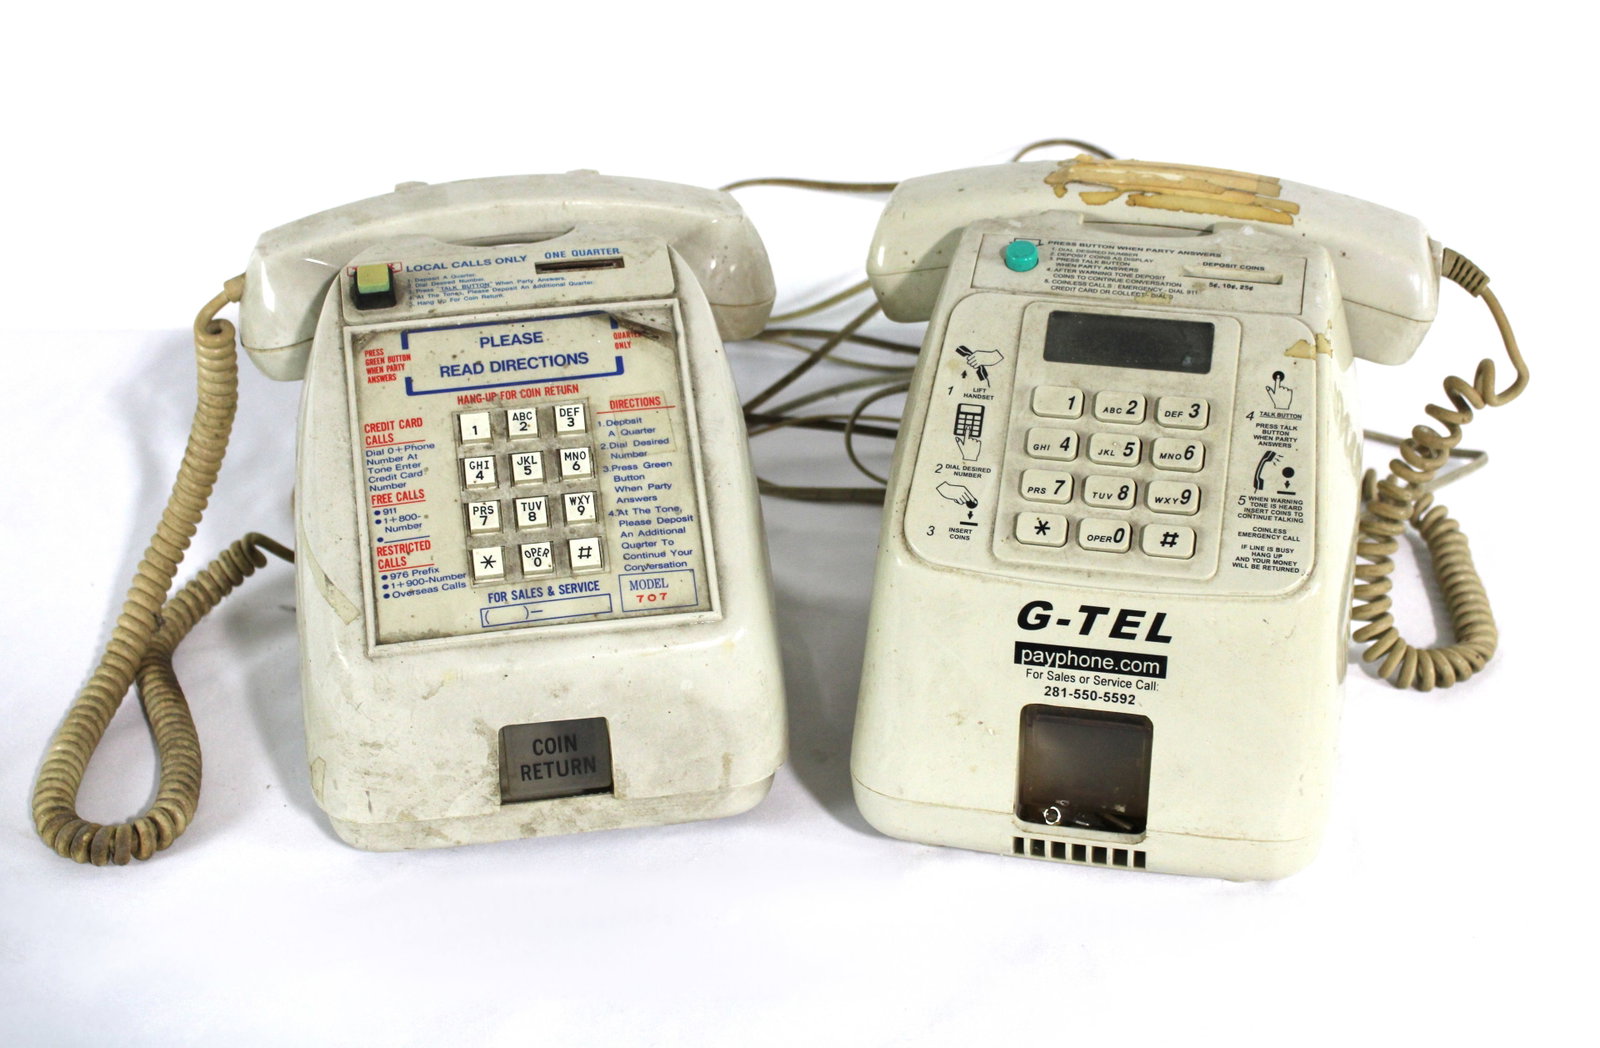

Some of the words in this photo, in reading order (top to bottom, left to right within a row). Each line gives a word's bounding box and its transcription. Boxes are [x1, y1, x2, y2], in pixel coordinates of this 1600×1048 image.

[544, 251, 566, 260] ONE
[571, 248, 620, 258] QUARTER
[406, 262, 449, 273] LOCAL
[451, 258, 492, 270] CALLS
[494, 255, 527, 266] ONLY
[480, 332, 544, 348] PLEASE
[614, 341, 632, 350] ONLY
[364, 348, 384, 357] PRESS
[366, 357, 385, 366] GREEN
[388, 354, 411, 363] BUTTON
[440, 364, 484, 378] READ
[490, 352, 589, 372] DIRECTIONS
[366, 366, 384, 374] WHEN
[387, 364, 405, 372] PARTY
[368, 374, 396, 384] ANSWERS
[457, 393, 497, 405] HANG-UP
[500, 390, 517, 400] FOR
[520, 388, 541, 398] COIN
[544, 384, 579, 396] RETURN
[610, 396, 661, 410] DIRECTIONS
[1068, 396, 1076, 410] 1
[1126, 400, 1138, 414] 2
[560, 407, 580, 417] DEF
[1188, 404, 1200, 418] 3
[1246, 411, 1254, 420] 4
[512, 412, 532, 421] ABC
[364, 420, 395, 434] CREDIT
[398, 418, 423, 430] CARD
[520, 422, 528, 432] 2
[567, 418, 575, 428] 3
[472, 426, 478, 436] 1
[620, 428, 656, 436] Quarter
[366, 433, 394, 446] CALLS
[633, 438, 670, 447] Desired
[1060, 436, 1070, 451] 4
[366, 448, 384, 457] Dial
[1123, 442, 1135, 456] 5
[1184, 445, 1196, 460] 6
[564, 451, 586, 460] MNO
[610, 452, 648, 460] Number
[366, 456, 404, 466] Number
[470, 460, 490, 470] GHI
[517, 456, 538, 466] JKL
[572, 461, 580, 470] 6
[368, 466, 392, 474] Tone
[395, 462, 421, 471] Enter
[524, 466, 532, 476] 5
[935, 464, 944, 474] 2
[963, 466, 992, 474] DESIRED
[368, 474, 397, 484] Credit
[400, 470, 423, 480] Card
[476, 471, 484, 480] 4
[614, 474, 645, 482] Button
[369, 482, 406, 492] Number
[1028, 486, 1046, 494] PRS
[1054, 480, 1065, 494] 7
[372, 493, 392, 504] FREE
[396, 489, 425, 502] CALLS
[1118, 485, 1129, 500] 8
[1155, 496, 1178, 504] WXY
[1180, 489, 1192, 504] 9
[570, 495, 590, 506] WXY
[616, 495, 658, 504] Answers
[1238, 496, 1246, 505] 5
[473, 506, 494, 516] PRS
[521, 501, 542, 511] TUV
[577, 506, 585, 516] 9
[480, 516, 488, 526] 7
[528, 512, 536, 522] 8
[656, 515, 694, 524] Deposit
[385, 523, 422, 533] Number
[638, 527, 686, 536] Additional
[926, 525, 936, 536] 3
[1087, 534, 1112, 543] OPER
[1113, 528, 1125, 544] 0
[1238, 532, 1280, 540] EMERGENCY
[377, 540, 430, 556] RESTRICTED
[622, 541, 657, 550] Quarter
[524, 547, 550, 558] OPER
[623, 552, 666, 560] Continue
[378, 556, 406, 569] CALLS
[534, 557, 542, 567] 0
[624, 561, 687, 572] Conversation
[390, 572, 408, 580] 976
[412, 568, 440, 576] Prefix
[630, 578, 668, 590] MODEL
[392, 586, 438, 598] Overseas
[442, 582, 466, 590] Calls
[488, 592, 506, 603] FOR
[512, 588, 543, 600] SALES
[548, 586, 554, 596] &
[558, 580, 600, 594] SERVICE
[1017, 600, 1172, 644] G-TEL
[1021, 649, 1160, 675] payphone.com
[1026, 669, 1043, 680] For
[1047, 671, 1076, 683] Sales
[1079, 676, 1090, 684] or
[1093, 675, 1132, 689] Service
[1136, 680, 1159, 692] Call:
[1044, 686, 1136, 705] 281-550-5592
[532, 734, 578, 756] COIN
[520, 756, 596, 781] RETURN
